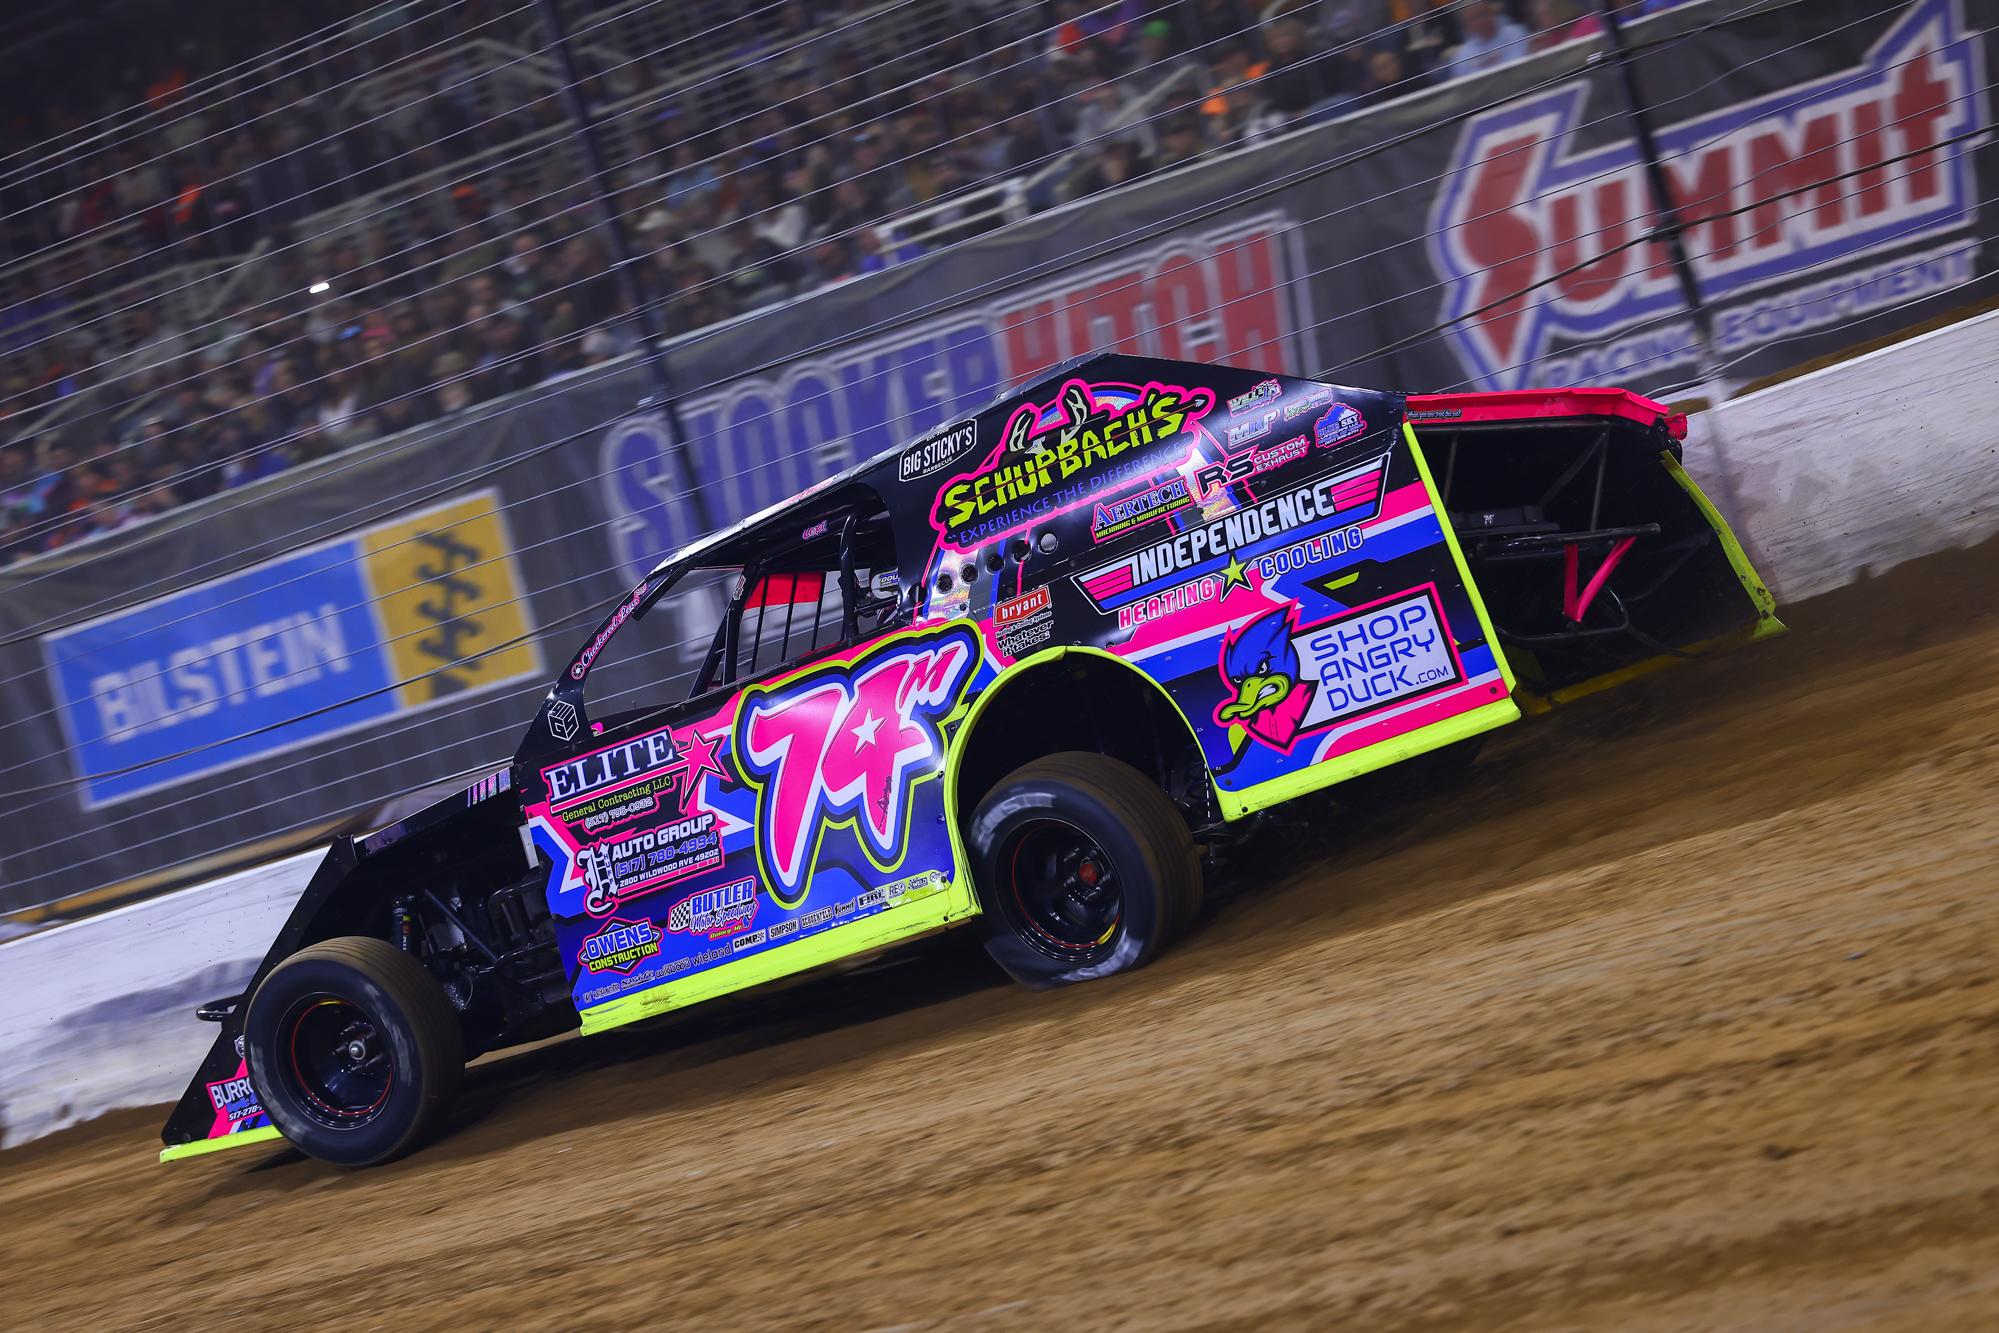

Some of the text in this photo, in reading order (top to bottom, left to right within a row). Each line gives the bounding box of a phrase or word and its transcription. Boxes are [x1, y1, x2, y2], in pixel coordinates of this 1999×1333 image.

[1340, 415, 1359, 427] SKY
[903, 450, 921, 476] BIG
[923, 426, 973, 467] STICKY'S
[922, 456, 953, 474] BARBECUE
[944, 393, 1185, 528] SCHUPBACH'S
[1253, 438, 1306, 464] CUSTOM
[1255, 446, 1308, 472] EXHAUST
[1052, 481, 1086, 508] THE
[1094, 479, 1188, 531] AERTECH
[1136, 497, 1190, 524] MANUFACTURING
[1131, 482, 1335, 586] INDEPENDENCE
[1119, 526, 1364, 631] HEATING COOLING
[1002, 593, 1043, 620] bryant
[997, 620, 1054, 650] Whatever
[1310, 605, 1427, 661] SHOP
[1003, 646, 1012, 658] it
[1320, 629, 1436, 686] ANGRY
[89, 604, 350, 745] BILSTEIN
[545, 733, 674, 801] ELITE
[562, 776, 671, 822] General Contracting LLC
[612, 814, 714, 861] AUTO GROUP
[614, 831, 718, 878] (517) 780-4994
[620, 876, 638, 887] 2800
[639, 862, 678, 882] WILDWOOD
[694, 848, 719, 862] 49202
[691, 879, 754, 915] BUTLER
[690, 901, 757, 932] Motor Speedway
[770, 921, 797, 938] SIMPSON
[585, 921, 653, 958] OWENS
[588, 942, 659, 971] CONSTRUCTION
[692, 942, 732, 966] wieland
[734, 934, 758, 949] COMP
